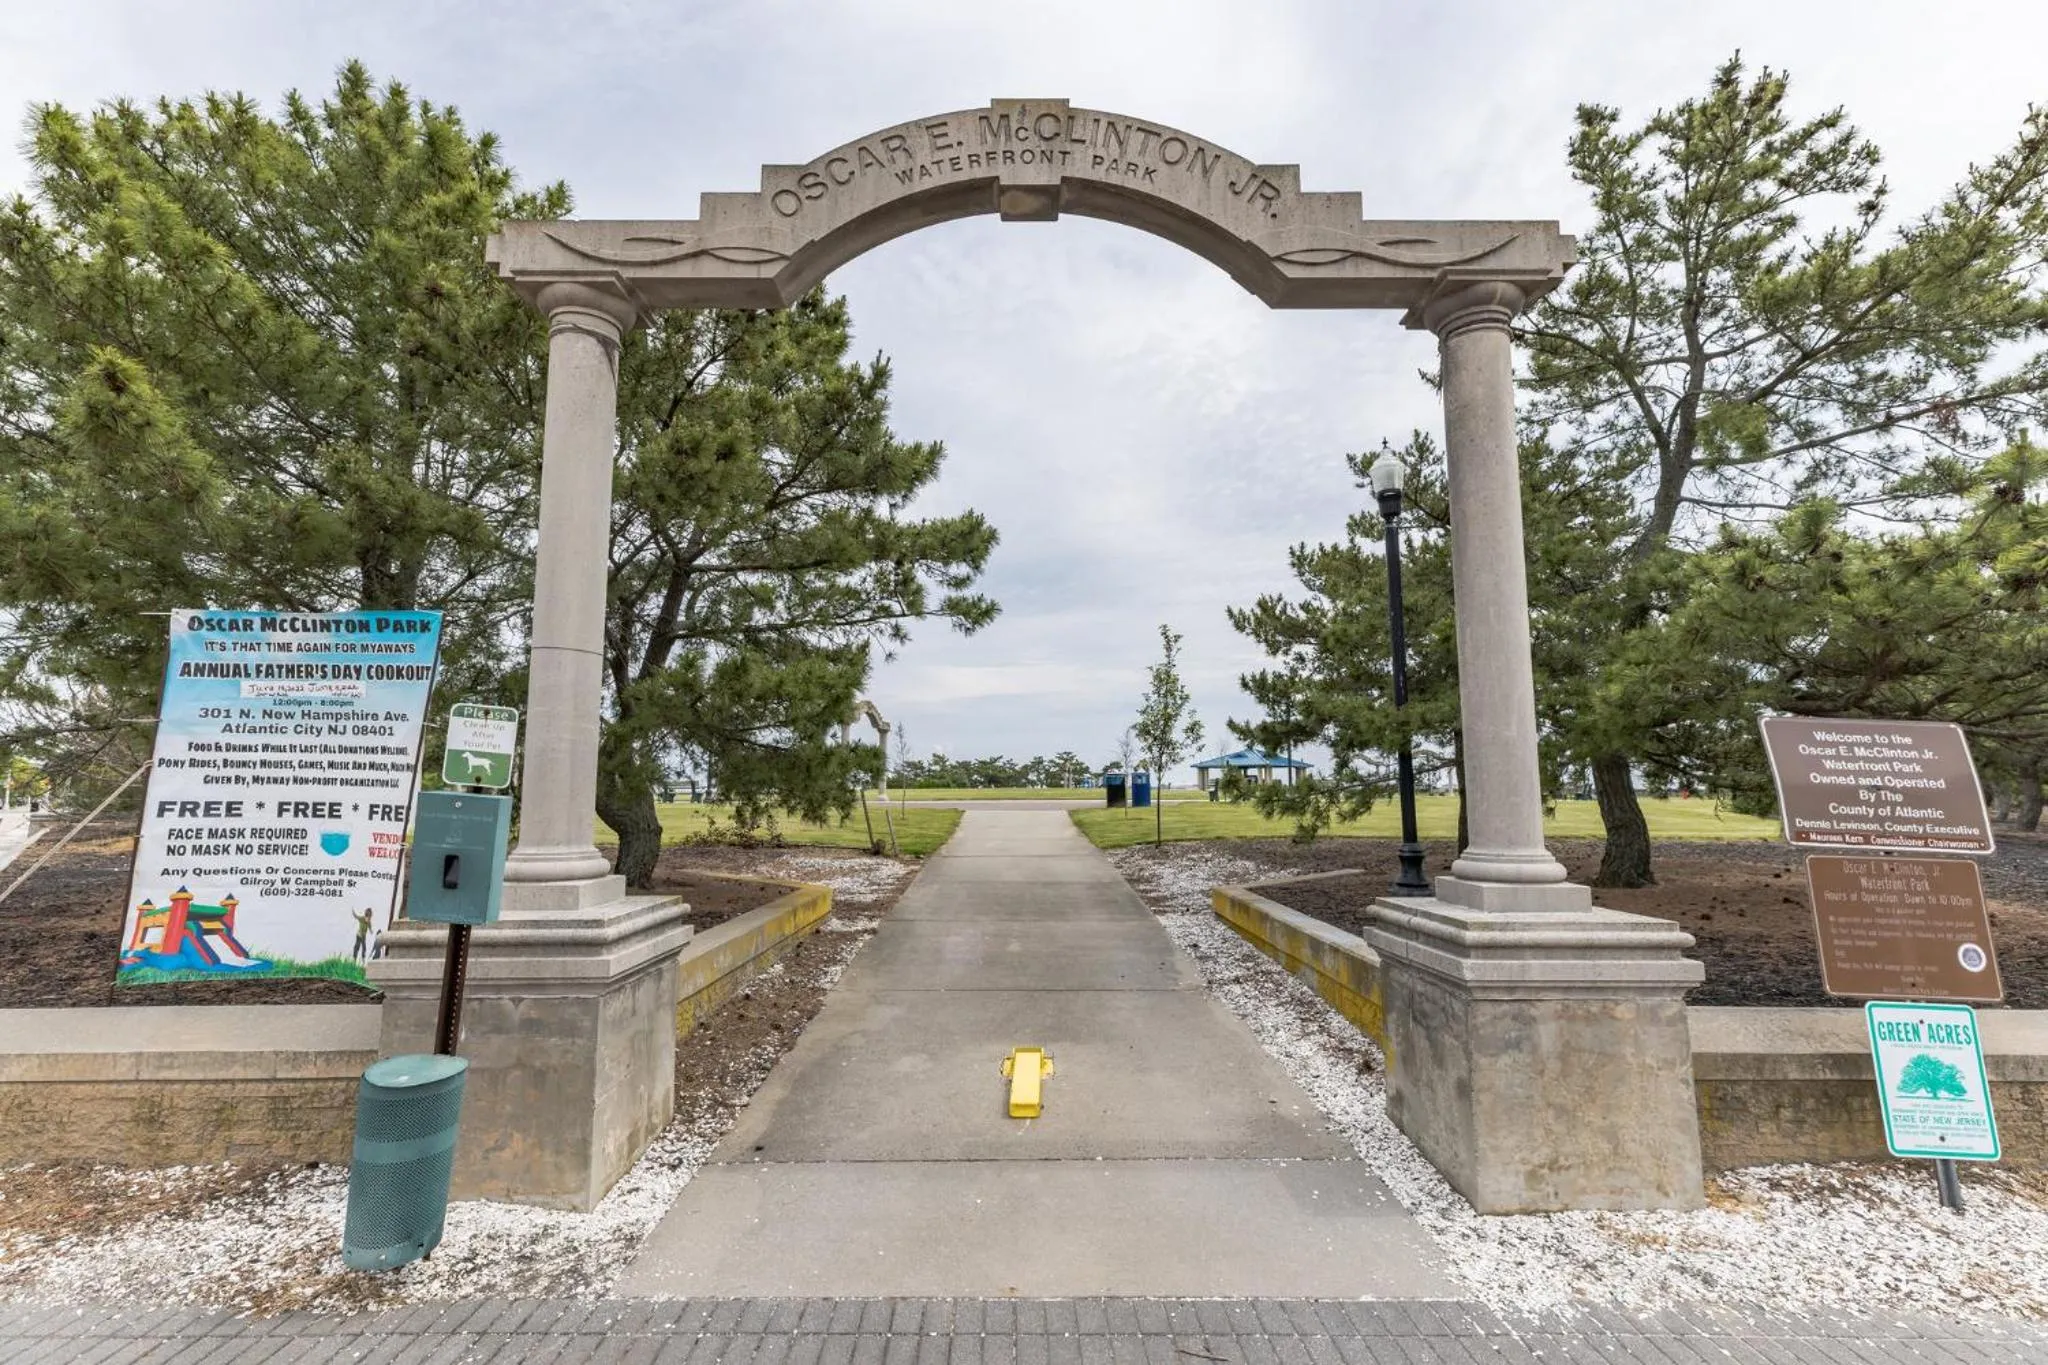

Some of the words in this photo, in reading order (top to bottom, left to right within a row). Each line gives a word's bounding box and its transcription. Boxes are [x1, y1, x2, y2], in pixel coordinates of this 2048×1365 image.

[770, 131, 913, 218] OSCAR
[925, 121, 964, 151] E.
[1228, 168, 1282, 220] JR.
[894, 150, 1072, 185] WATERFRONT
[1092, 155, 1158, 184] PARK
[188, 616, 253, 632] OSCAR
[377, 619, 431, 633] PARK
[204, 642, 226, 652] IT'S
[232, 642, 262, 652] THAT
[266, 642, 292, 652] TIME
[296, 642, 331, 653] AGAIN
[335, 643, 356, 653] FOR
[360, 643, 415, 654] MYAWAYS
[179, 662, 251, 678] ANNUAL
[256, 663, 327, 680] FATHER'S
[332, 665, 362, 680] DAY
[366, 666, 431, 680] COOKOUT
[199, 708, 232, 719] 301
[239, 708, 256, 720] N.
[262, 709, 294, 721] New
[301, 709, 378, 723] Hampshire
[384, 710, 409, 722] Ave.
[464, 707, 509, 720] Please
[221, 723, 288, 735] Atlantic
[293, 723, 322, 738] City
[328, 724, 346, 736] NJ
[352, 725, 394, 736] 08401
[1813, 731, 1871, 743] Welcome
[1875, 734, 1887, 743] to
[1891, 734, 1912, 745] the
[225, 743, 259, 754] DRINKS
[261, 744, 286, 754] WHILE
[298, 744, 318, 755] LAST
[338, 745, 378, 756] DONATIONS
[1799, 744, 1836, 756] Oscar
[1839, 745, 1852, 756] E.
[1855, 747, 1919, 759] McClinton
[1922, 749, 1938, 759] Jr.
[158, 758, 185, 770] PONY
[223, 759, 256, 771] BOUNCY
[328, 761, 349, 771] MUSIC
[1823, 760, 1891, 772] Waterfront
[1894, 762, 1923, 772] Park
[203, 775, 232, 786] GIVEN
[1810, 773, 1855, 785] Owned
[1858, 775, 1882, 786] and
[1885, 776, 1945, 789] Operated
[1859, 790, 1876, 801] By
[1880, 790, 1903, 801] The
[157, 801, 244, 818] FREE
[277, 802, 342, 819] FREE
[1828, 803, 1875, 818] County
[1878, 805, 1891, 816] of
[1895, 805, 1945, 818] Atlantic
[168, 828, 203, 839] FACE
[207, 829, 246, 839] MASK
[250, 829, 308, 839] REQUIRED
[1885, 822, 1923, 834] County
[1926, 824, 1980, 835] Executive
[1871, 835, 1925, 847] Commissioner
[1928, 838, 1980, 849] Chairwoman
[166, 844, 186, 856] NO
[191, 844, 230, 855] MASK
[235, 844, 253, 855] NO
[257, 844, 308, 855] SERVICE!
[161, 867, 188, 877] Any
[193, 866, 261, 876] Questions
[266, 867, 280, 875] Or
[284, 867, 336, 876] Concerns
[339, 868, 369, 878] Please
[1843, 862, 1867, 874] Oscar
[240, 877, 277, 888] Gilroy
[280, 878, 292, 886] W
[295, 878, 344, 887] Campbell
[347, 879, 357, 887] Sr
[1861, 877, 1907, 890] Waterfront
[1911, 879, 1931, 891] Park
[1824, 891, 1848, 901] Hours
[1877, 1021, 1921, 1041] GREEN
[1928, 1024, 1972, 1045] ACRES
[1893, 1115, 1917, 1124] STATE
[1919, 1115, 1928, 1124] OF
[1933, 1116, 1952, 1124] NEW
[1956, 1117, 1986, 1126] JERSEY
